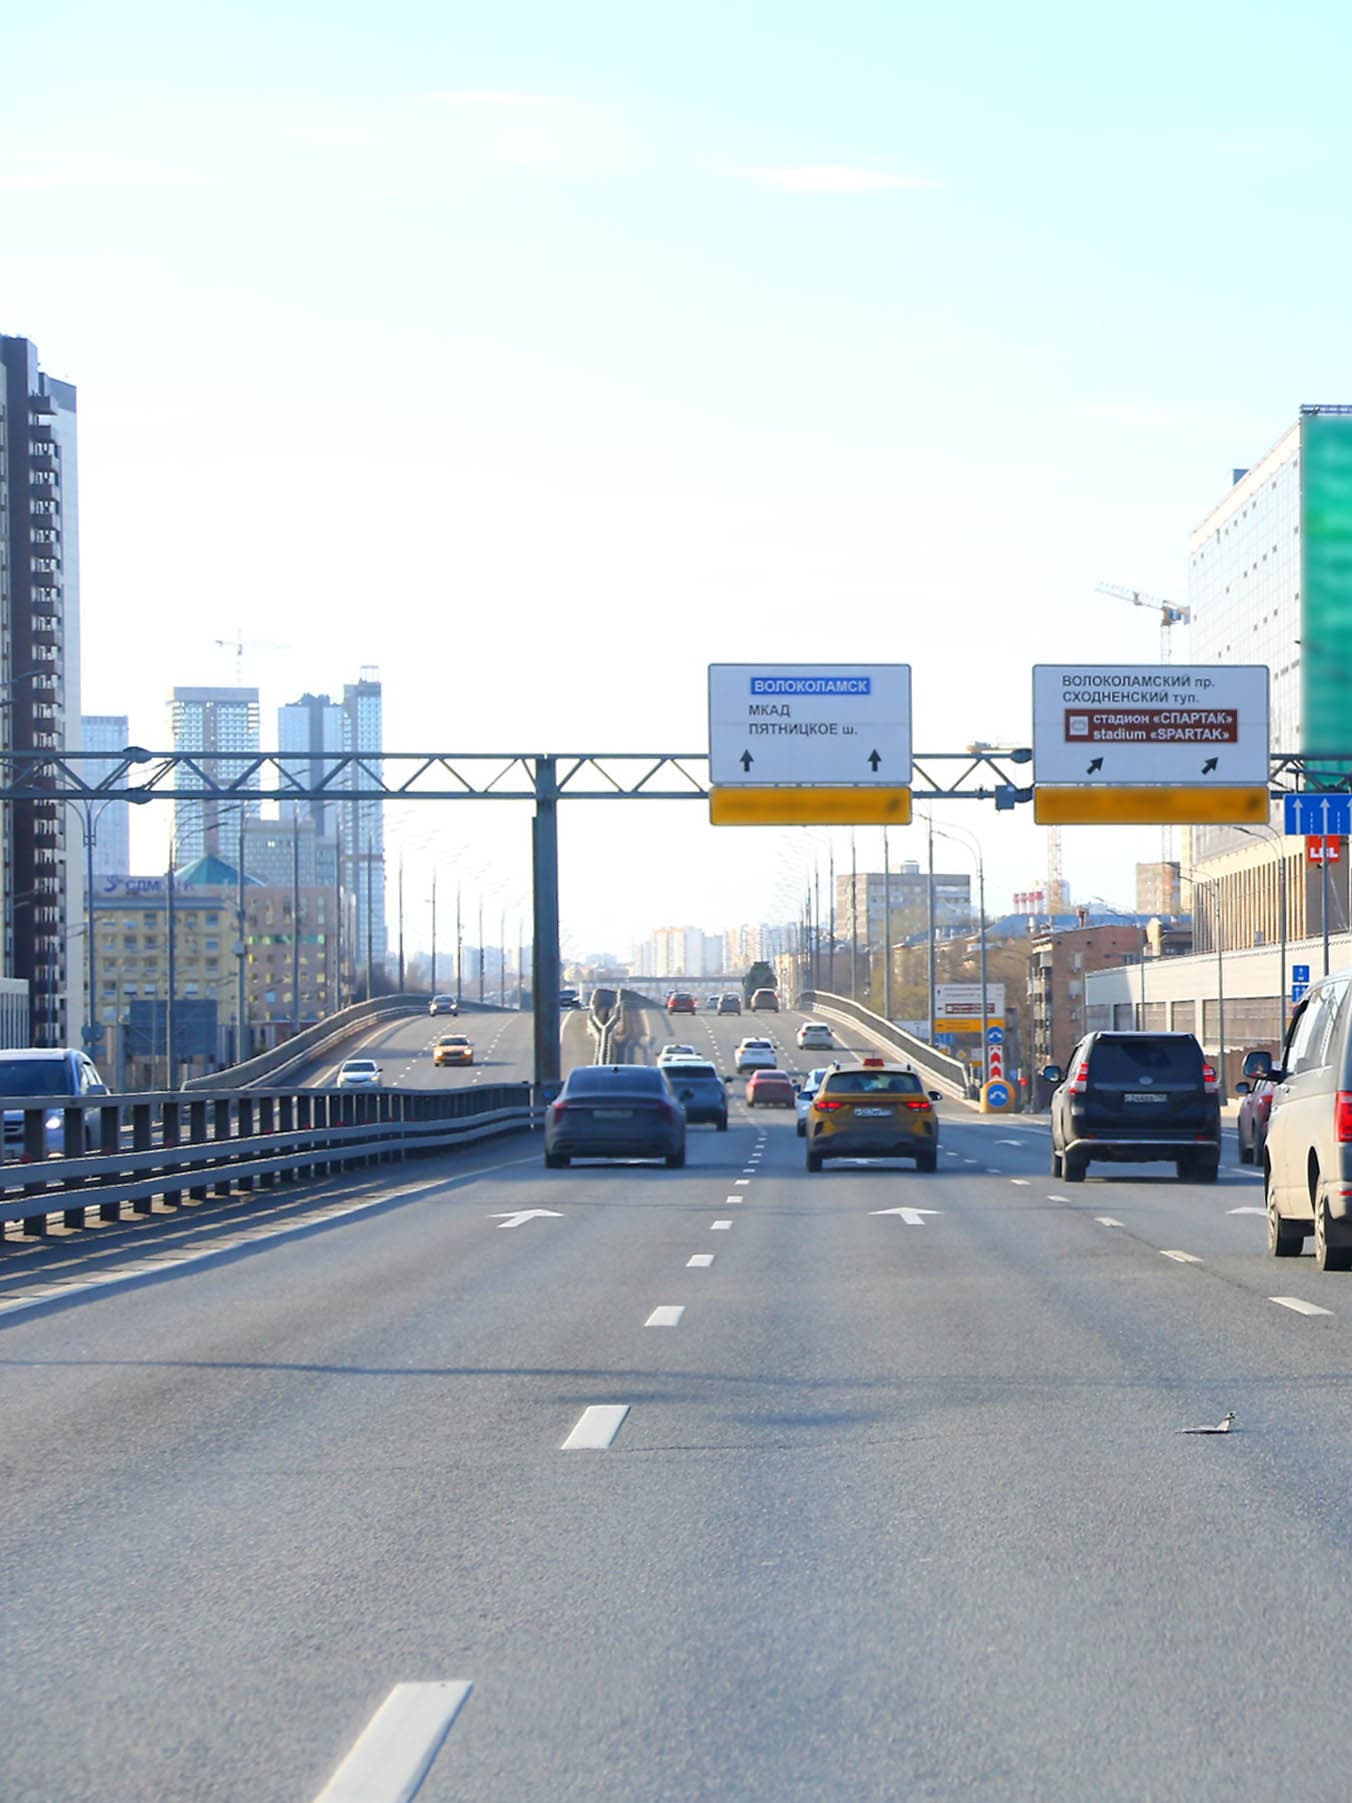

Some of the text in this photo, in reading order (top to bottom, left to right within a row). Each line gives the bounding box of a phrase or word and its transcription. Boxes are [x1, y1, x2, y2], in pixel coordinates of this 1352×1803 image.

[754, 680, 867, 693] ВОЛОКОЛАМСК
[1062, 674, 1216, 689] ВОЛОКОЛАМСКИЙ пр.
[1062, 690, 1200, 705] СХОДНЕНСКИЙ туп.
[748, 704, 791, 717] МКАД
[1093, 712, 1233, 725] стадион «СПАРТАК»
[748, 723, 858, 736] ПЯТНИЦКОЕ ш.
[1093, 728, 1230, 740] stadium «SPARTAK»
